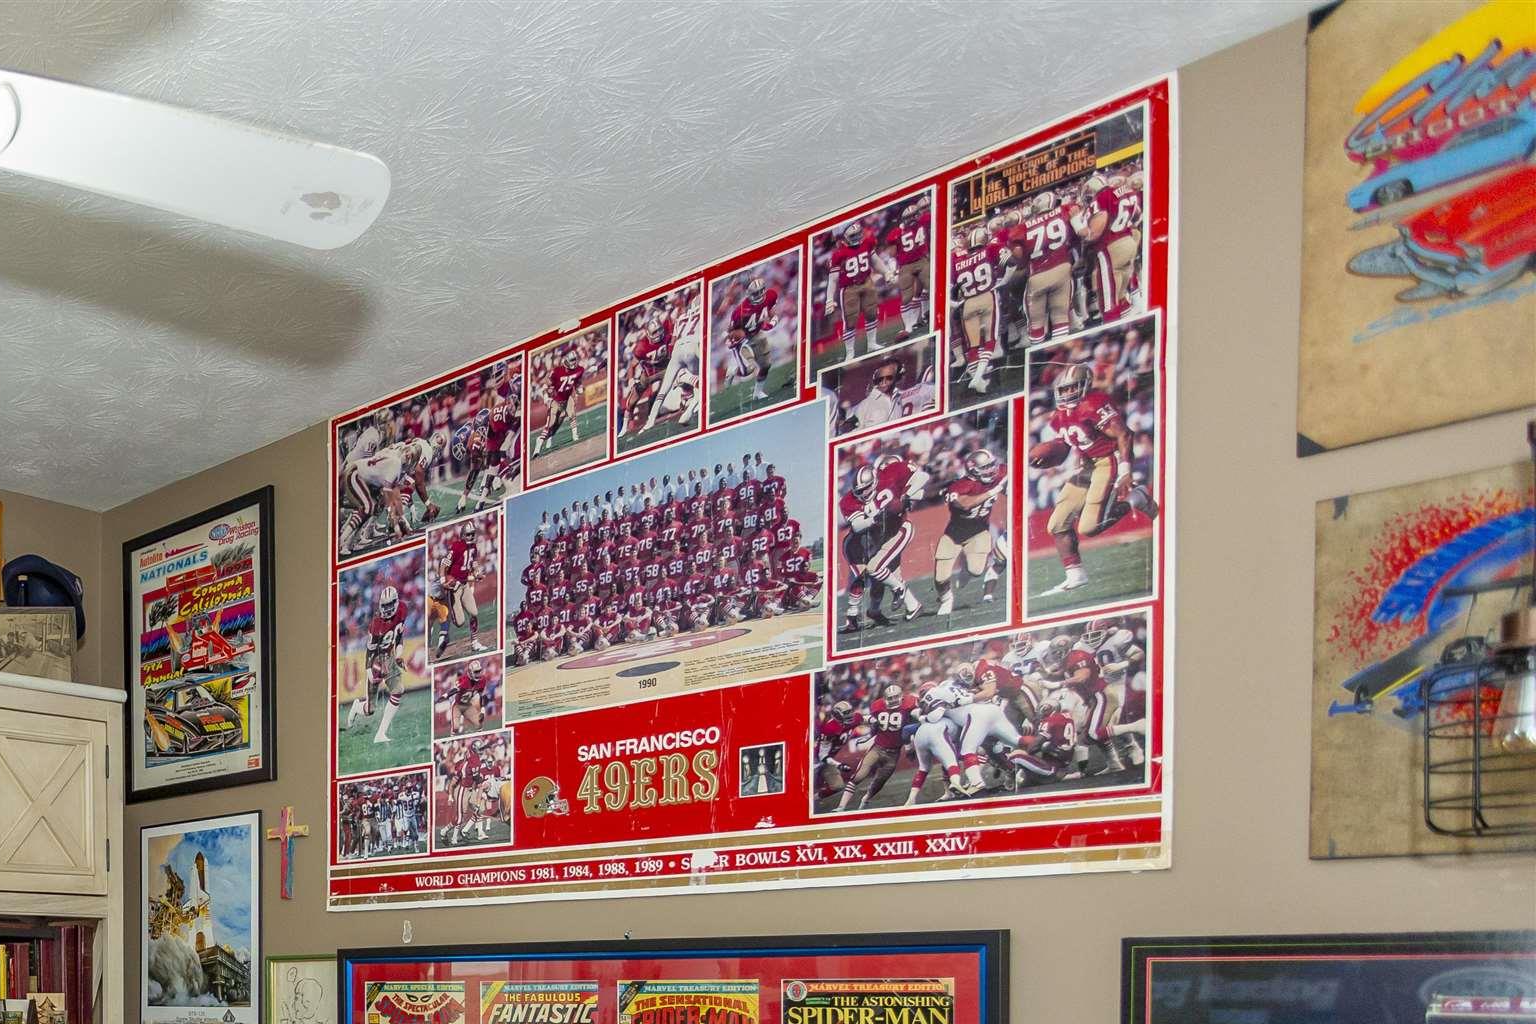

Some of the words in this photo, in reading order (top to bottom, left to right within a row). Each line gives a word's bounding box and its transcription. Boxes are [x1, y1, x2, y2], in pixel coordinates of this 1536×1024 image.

[1023, 155, 1096, 192] CHAMPIONS
[901, 226, 925, 252] 54
[1027, 217, 1066, 259] 79
[845, 252, 869, 278] 95
[957, 262, 992, 297] 29
[139, 550, 209, 585] NATIONALS
[191, 574, 244, 599] Sonoma
[179, 586, 253, 617] California
[638, 677, 657, 689] 1990
[877, 711, 903, 731] 99
[577, 742, 612, 762] SAN
[615, 726, 721, 757] FRANCISCO
[576, 749, 720, 814] 49ERS
[415, 874, 454, 888] WORLD
[530, 866, 560, 880] 1981,
[562, 864, 593, 879] 1984,
[597, 862, 629, 877] 1988,
[634, 859, 664, 874] 1989
[735, 849, 791, 867] BOWLS
[795, 845, 828, 863] XVI,
[833, 843, 866, 860] XIX,
[872, 840, 919, 857] XXIII,
[504, 993, 523, 1003] THE
[525, 993, 581, 1003] FABULOUS
[644, 983, 677, 992] MARVEL
[679, 984, 721, 992] TREASURY
[722, 983, 758, 992] EDITION
[809, 983, 850, 992] MARVEL
[853, 983, 906, 992] TREASURY
[635, 997, 657, 1011] THE
[658, 995, 750, 1014] SENSATIONAL
[831, 996, 860, 1007] THE
[861, 995, 951, 1008] ASTONISHING
